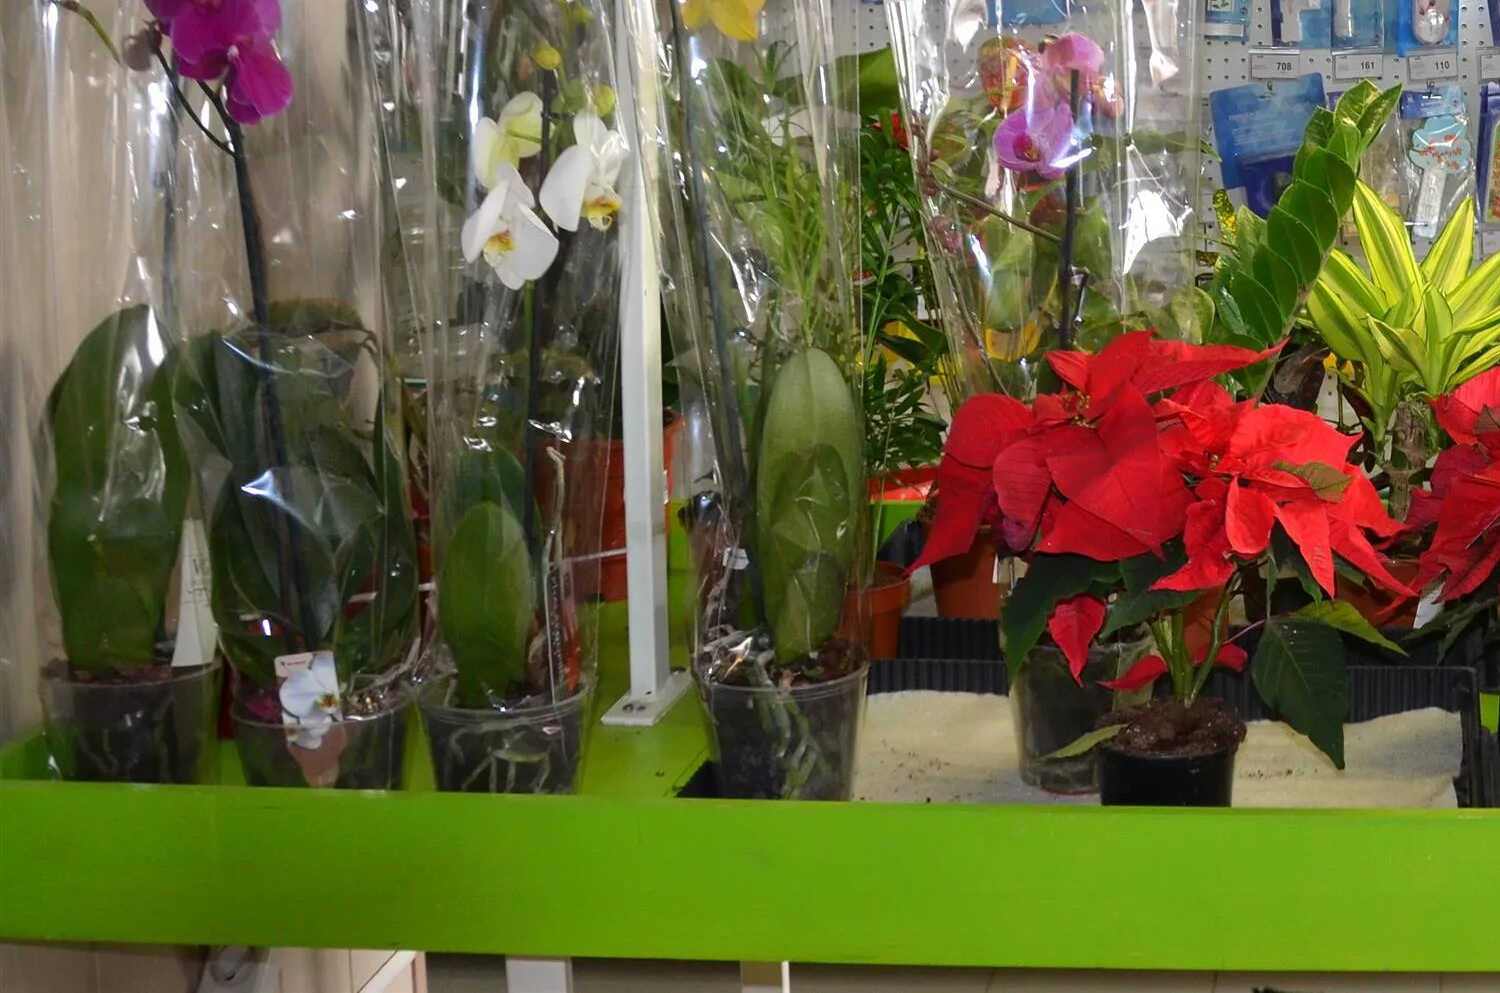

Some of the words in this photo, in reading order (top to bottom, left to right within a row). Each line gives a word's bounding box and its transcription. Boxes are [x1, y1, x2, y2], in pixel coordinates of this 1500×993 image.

[1276, 62, 1292, 71] 708
[1360, 61, 1375, 71] 161
[1434, 60, 1450, 71] 110
